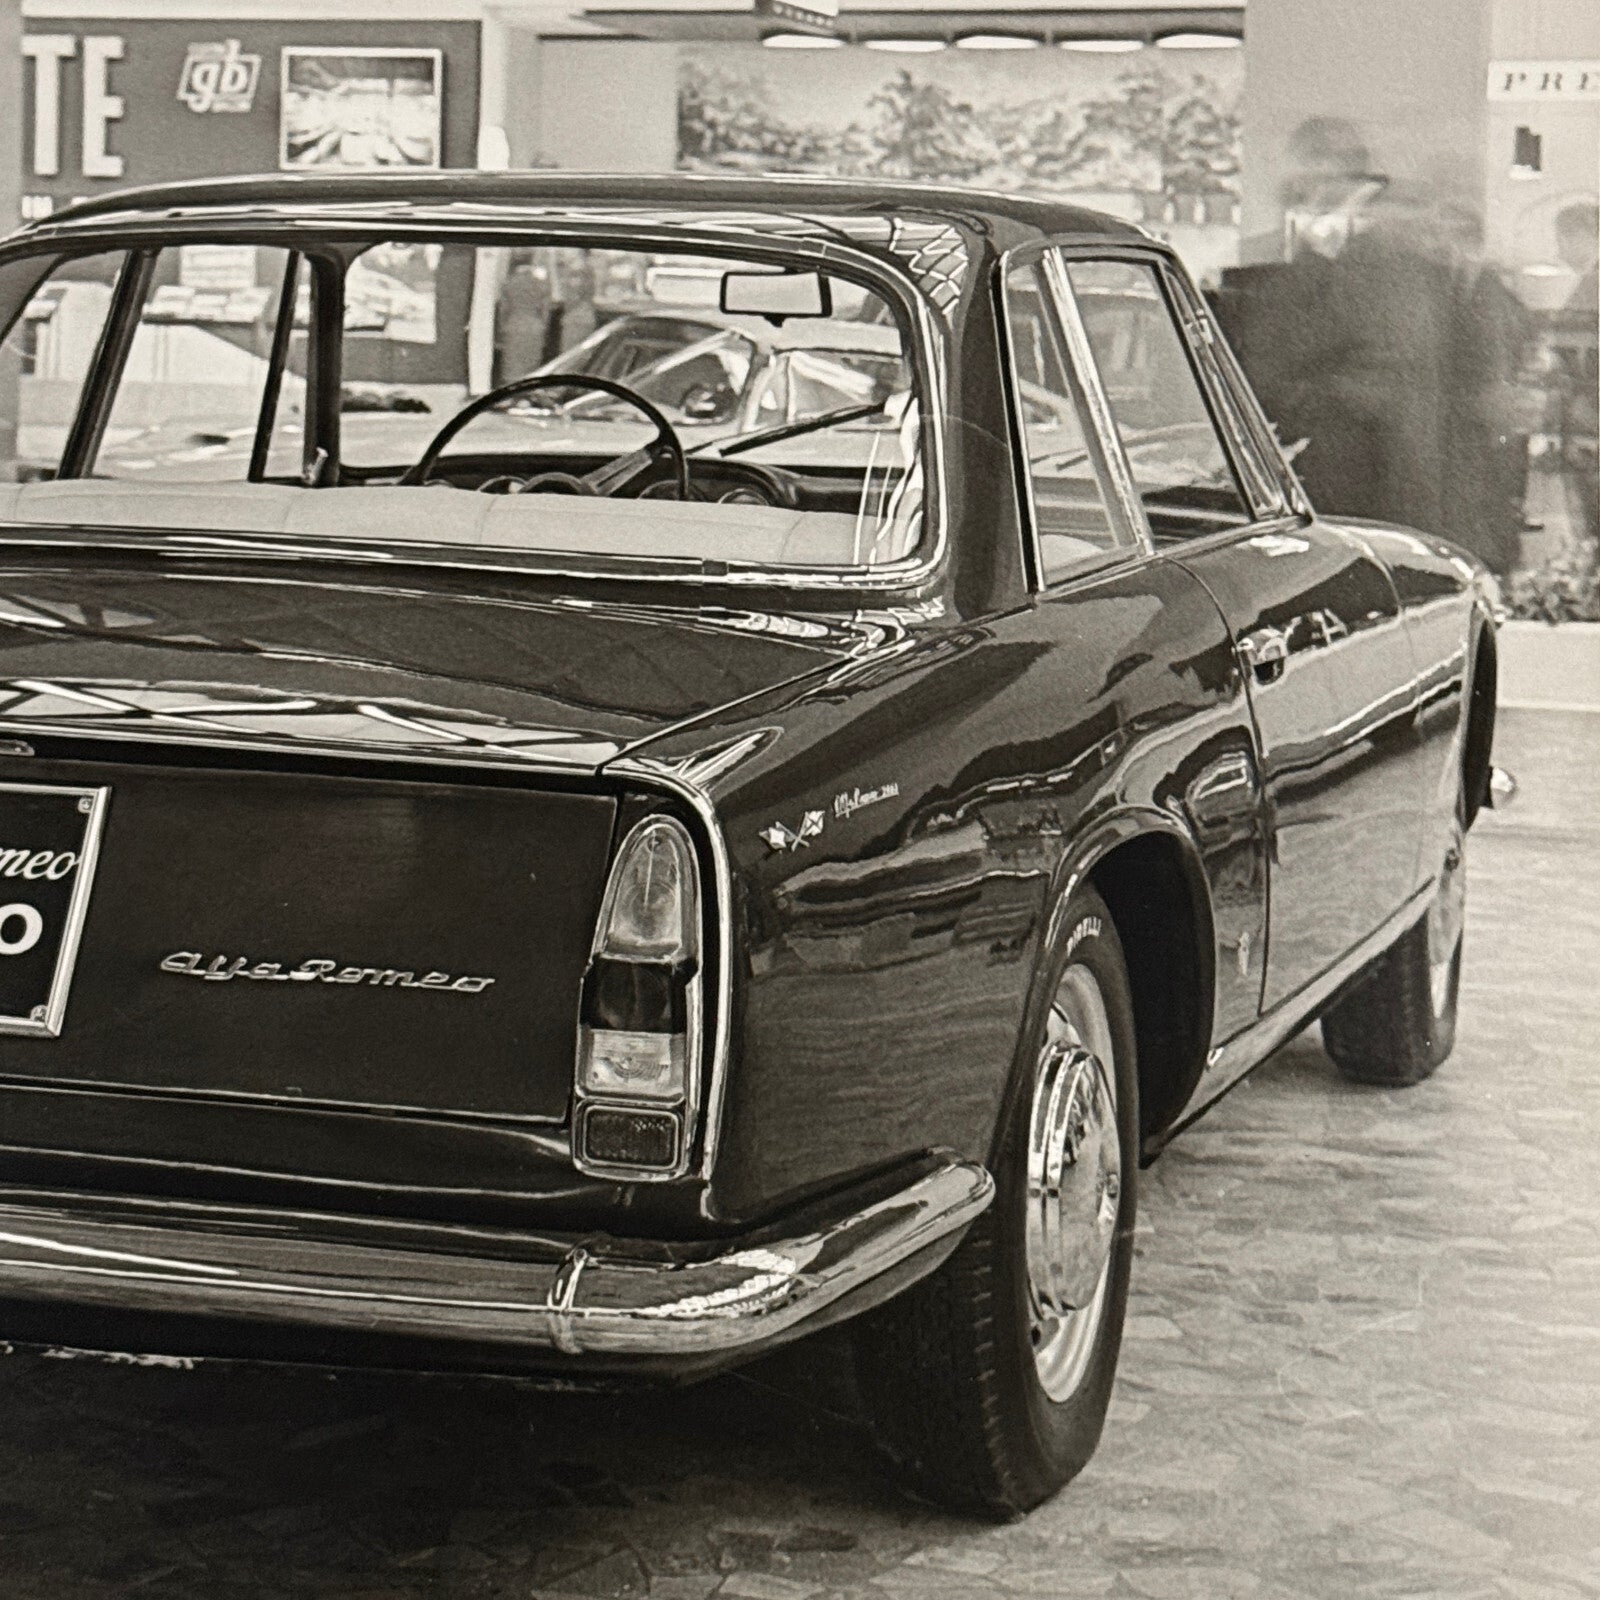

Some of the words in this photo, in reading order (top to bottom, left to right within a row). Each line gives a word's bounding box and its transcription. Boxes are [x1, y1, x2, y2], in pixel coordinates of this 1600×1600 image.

[21, 34, 125, 178] TE
[189, 38, 250, 114] gb
[1503, 71, 1600, 92] PRI
